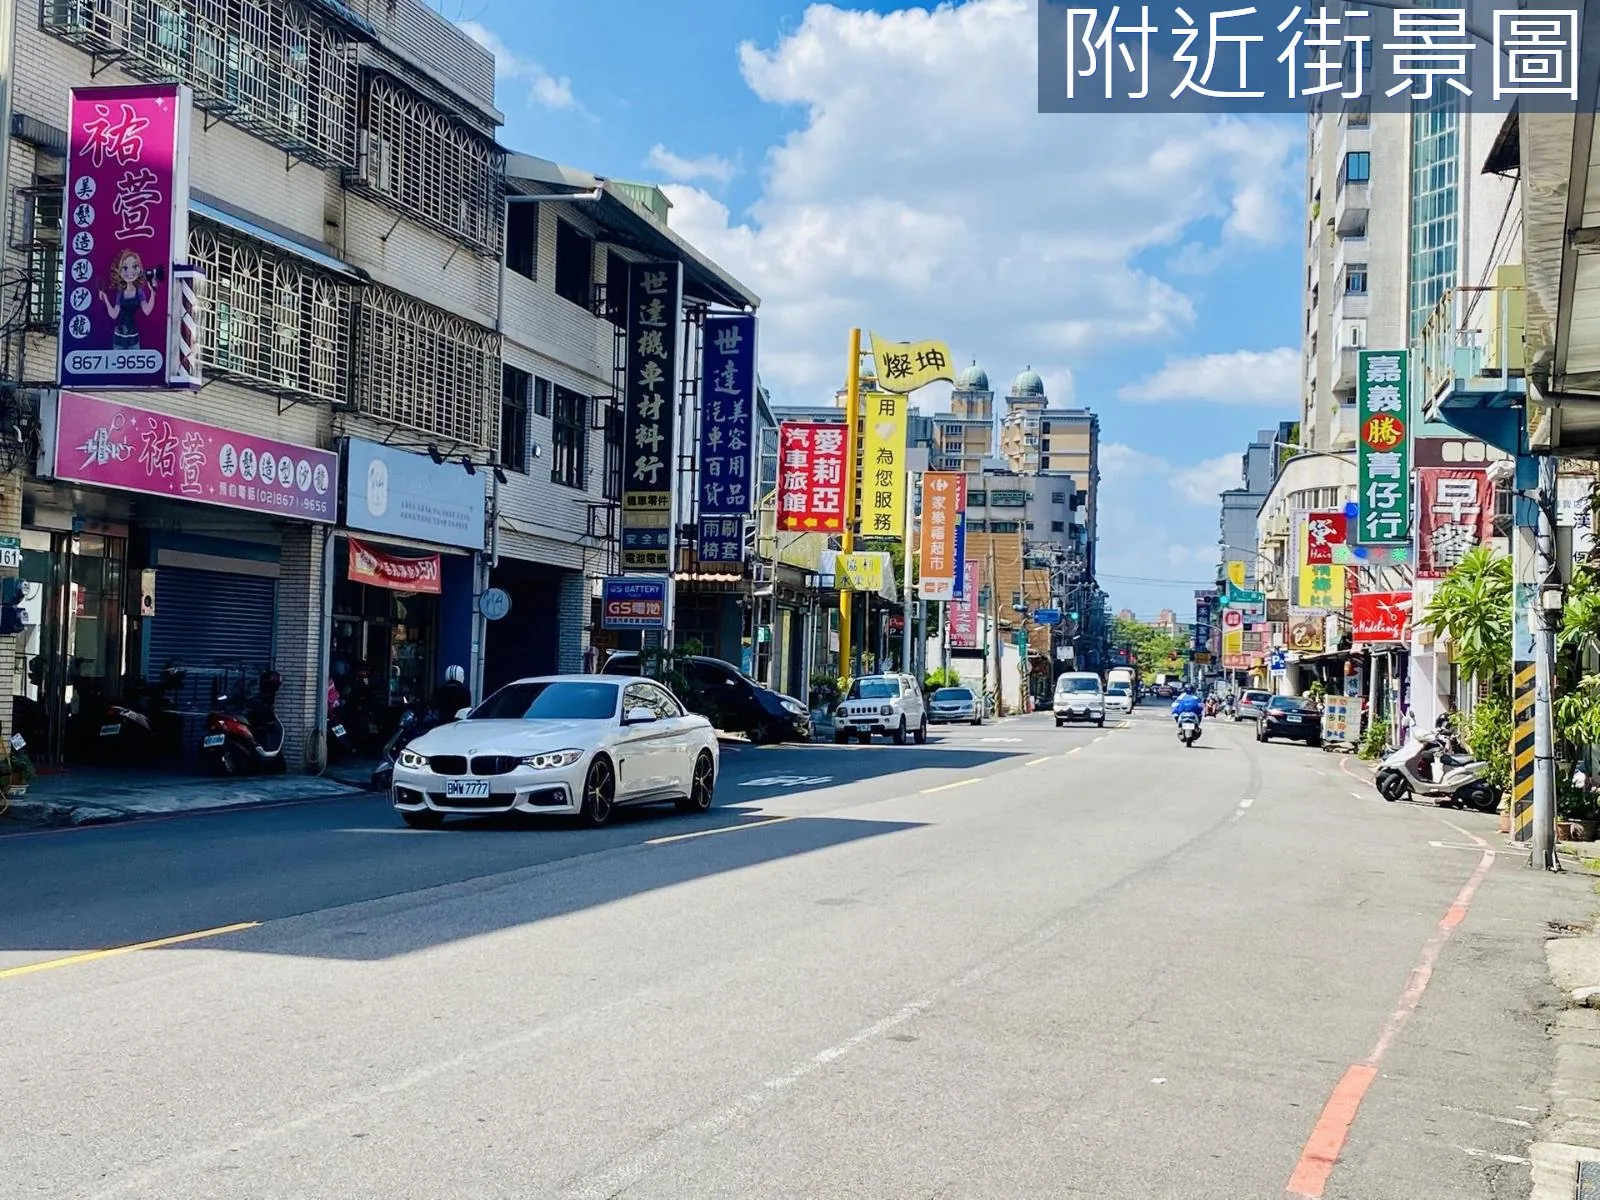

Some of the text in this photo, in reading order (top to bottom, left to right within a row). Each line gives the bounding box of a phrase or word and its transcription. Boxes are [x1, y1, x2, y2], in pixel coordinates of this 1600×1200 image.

[70, 177, 95, 337] 美髮造型沙龍
[72, 355, 156, 370] 8671-9656
[633, 271, 668, 484] 世達機車材料行
[713, 325, 743, 395] 世達
[883, 348, 945, 379] 燦坤
[704, 401, 726, 507] 汽車百貨
[726, 399, 748, 505] 美容用品
[783, 427, 809, 513] 汽車旅館
[811, 428, 843, 513] 愛莉亞
[625, 533, 668, 545] 安全帽
[608, 601, 661, 615] GS電池
